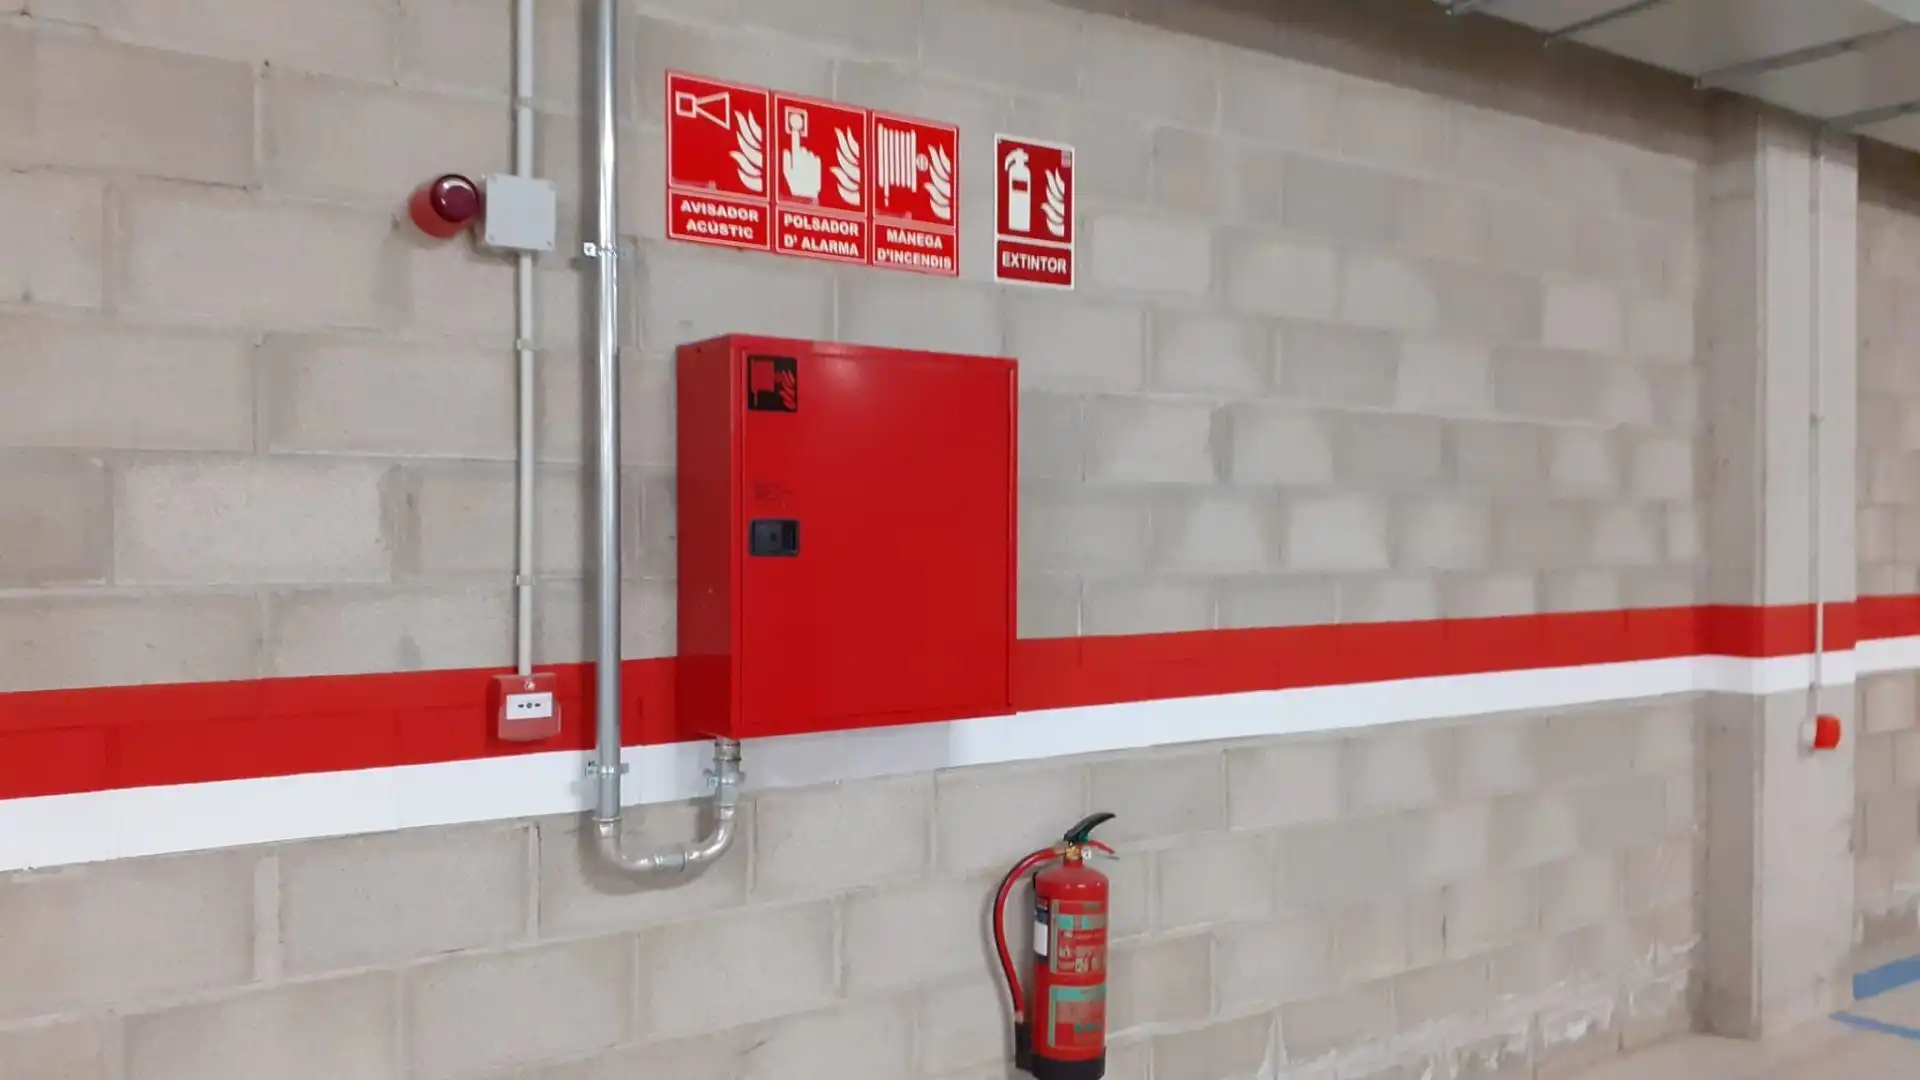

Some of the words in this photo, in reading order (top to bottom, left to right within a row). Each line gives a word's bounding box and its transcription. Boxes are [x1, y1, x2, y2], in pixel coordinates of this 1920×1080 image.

[681, 199, 759, 223] AVISADOR
[783, 213, 860, 237] POLSADOR
[801, 235, 859, 257] ALARMA
[876, 247, 952, 269] D'INCENDIS
[1002, 250, 1067, 275] EXTINTOR
